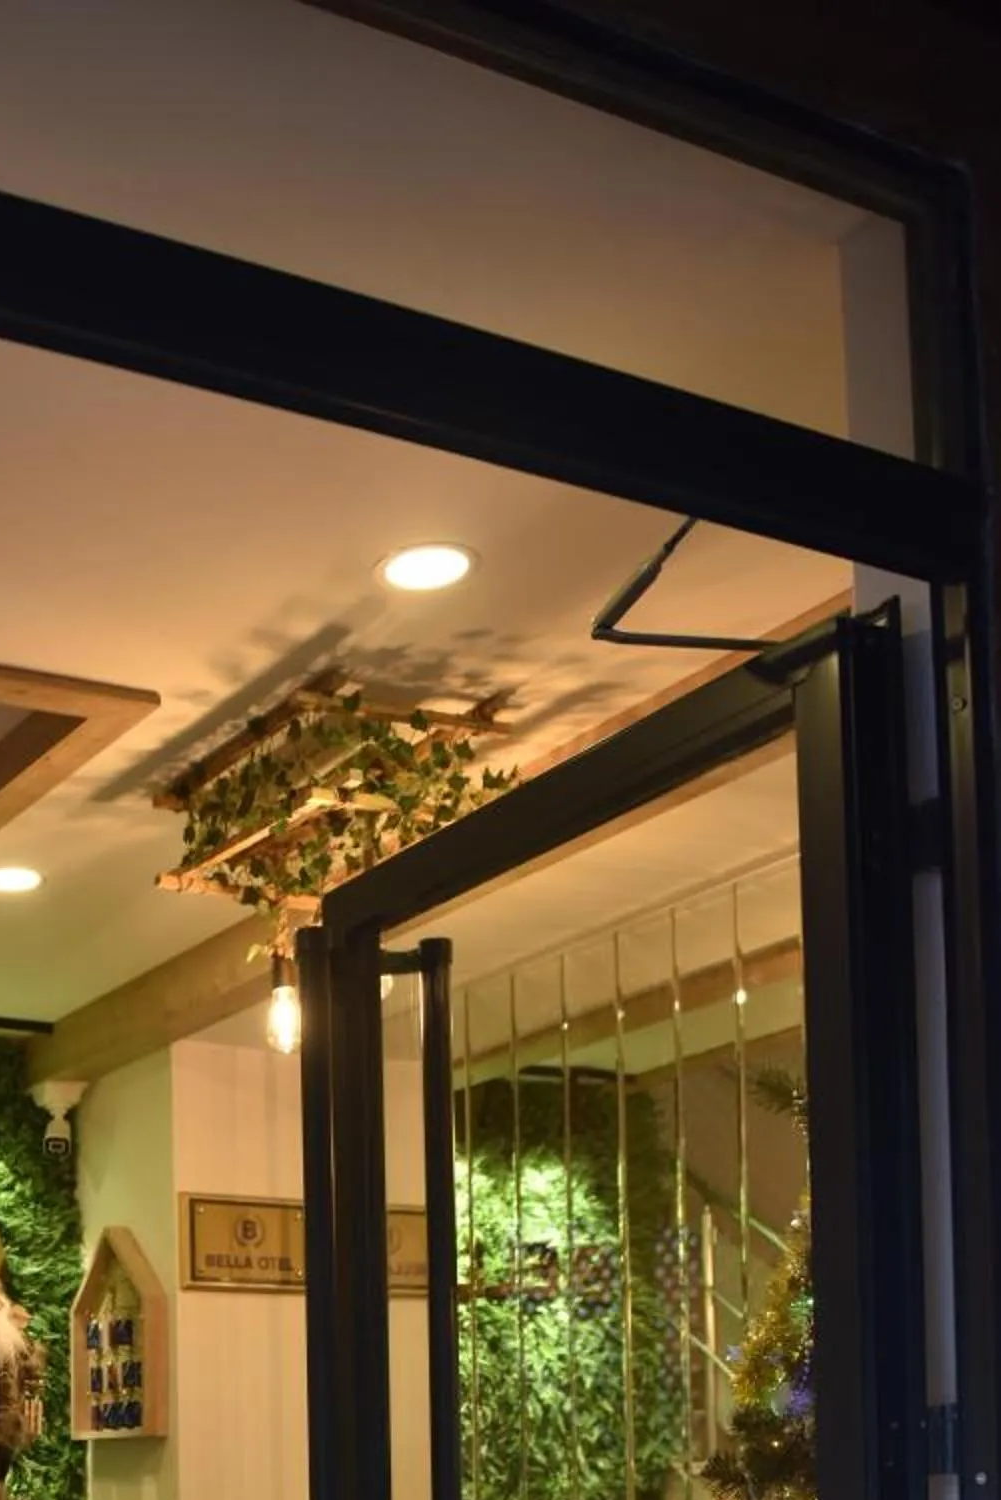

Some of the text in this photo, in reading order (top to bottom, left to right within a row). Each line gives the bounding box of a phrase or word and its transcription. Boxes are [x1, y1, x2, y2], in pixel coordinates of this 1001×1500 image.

[242, 1220, 257, 1240] B
[206, 1254, 294, 1272] BELLA OTEL
